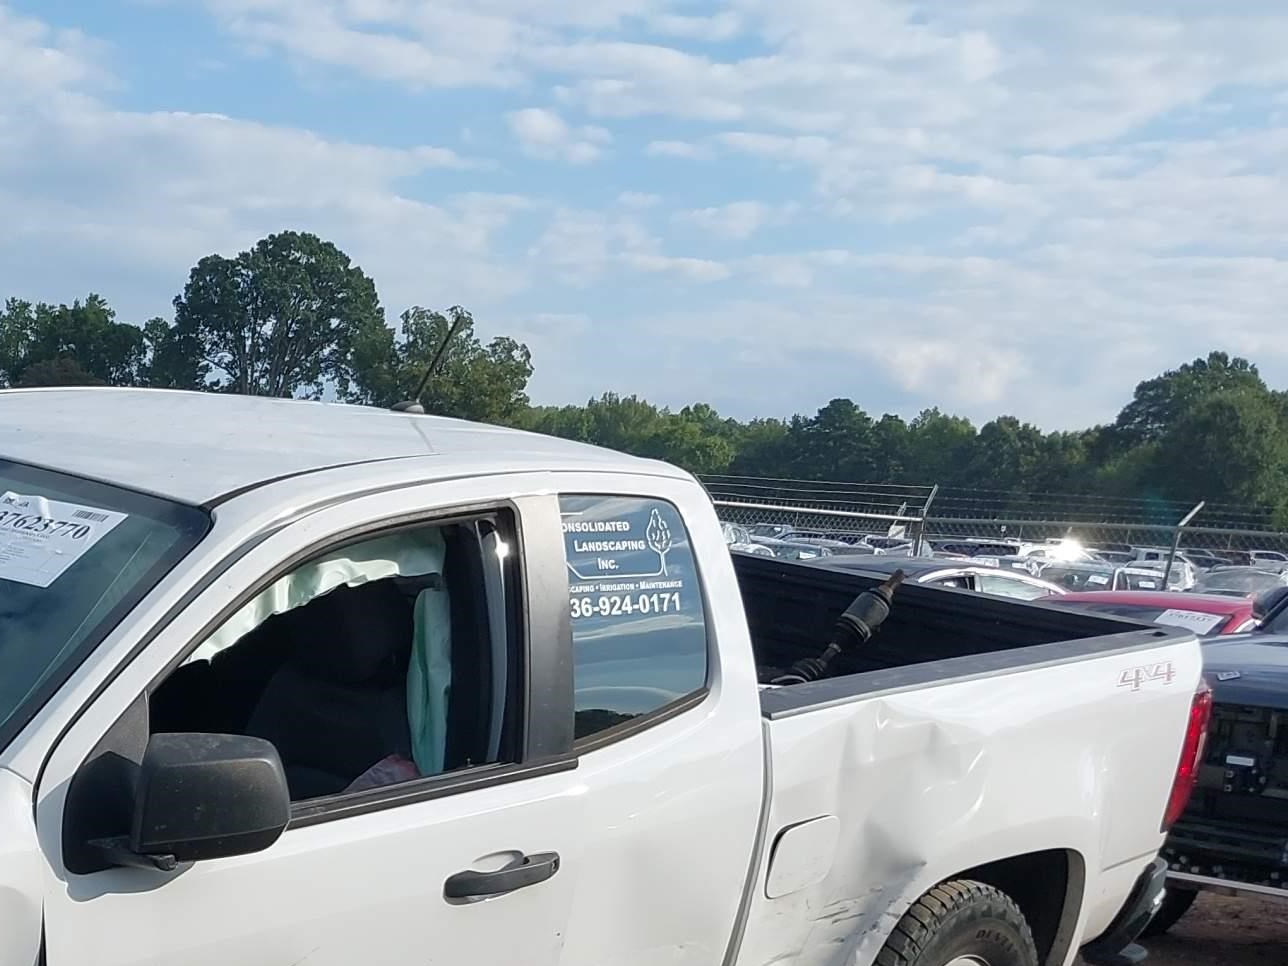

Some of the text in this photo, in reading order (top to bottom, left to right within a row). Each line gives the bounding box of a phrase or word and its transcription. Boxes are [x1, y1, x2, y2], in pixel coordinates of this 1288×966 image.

[574, 539, 646, 552] LANDSCAPING
[569, 584, 595, 593] CAPING
[570, 592, 681, 618] 36-924-0171
